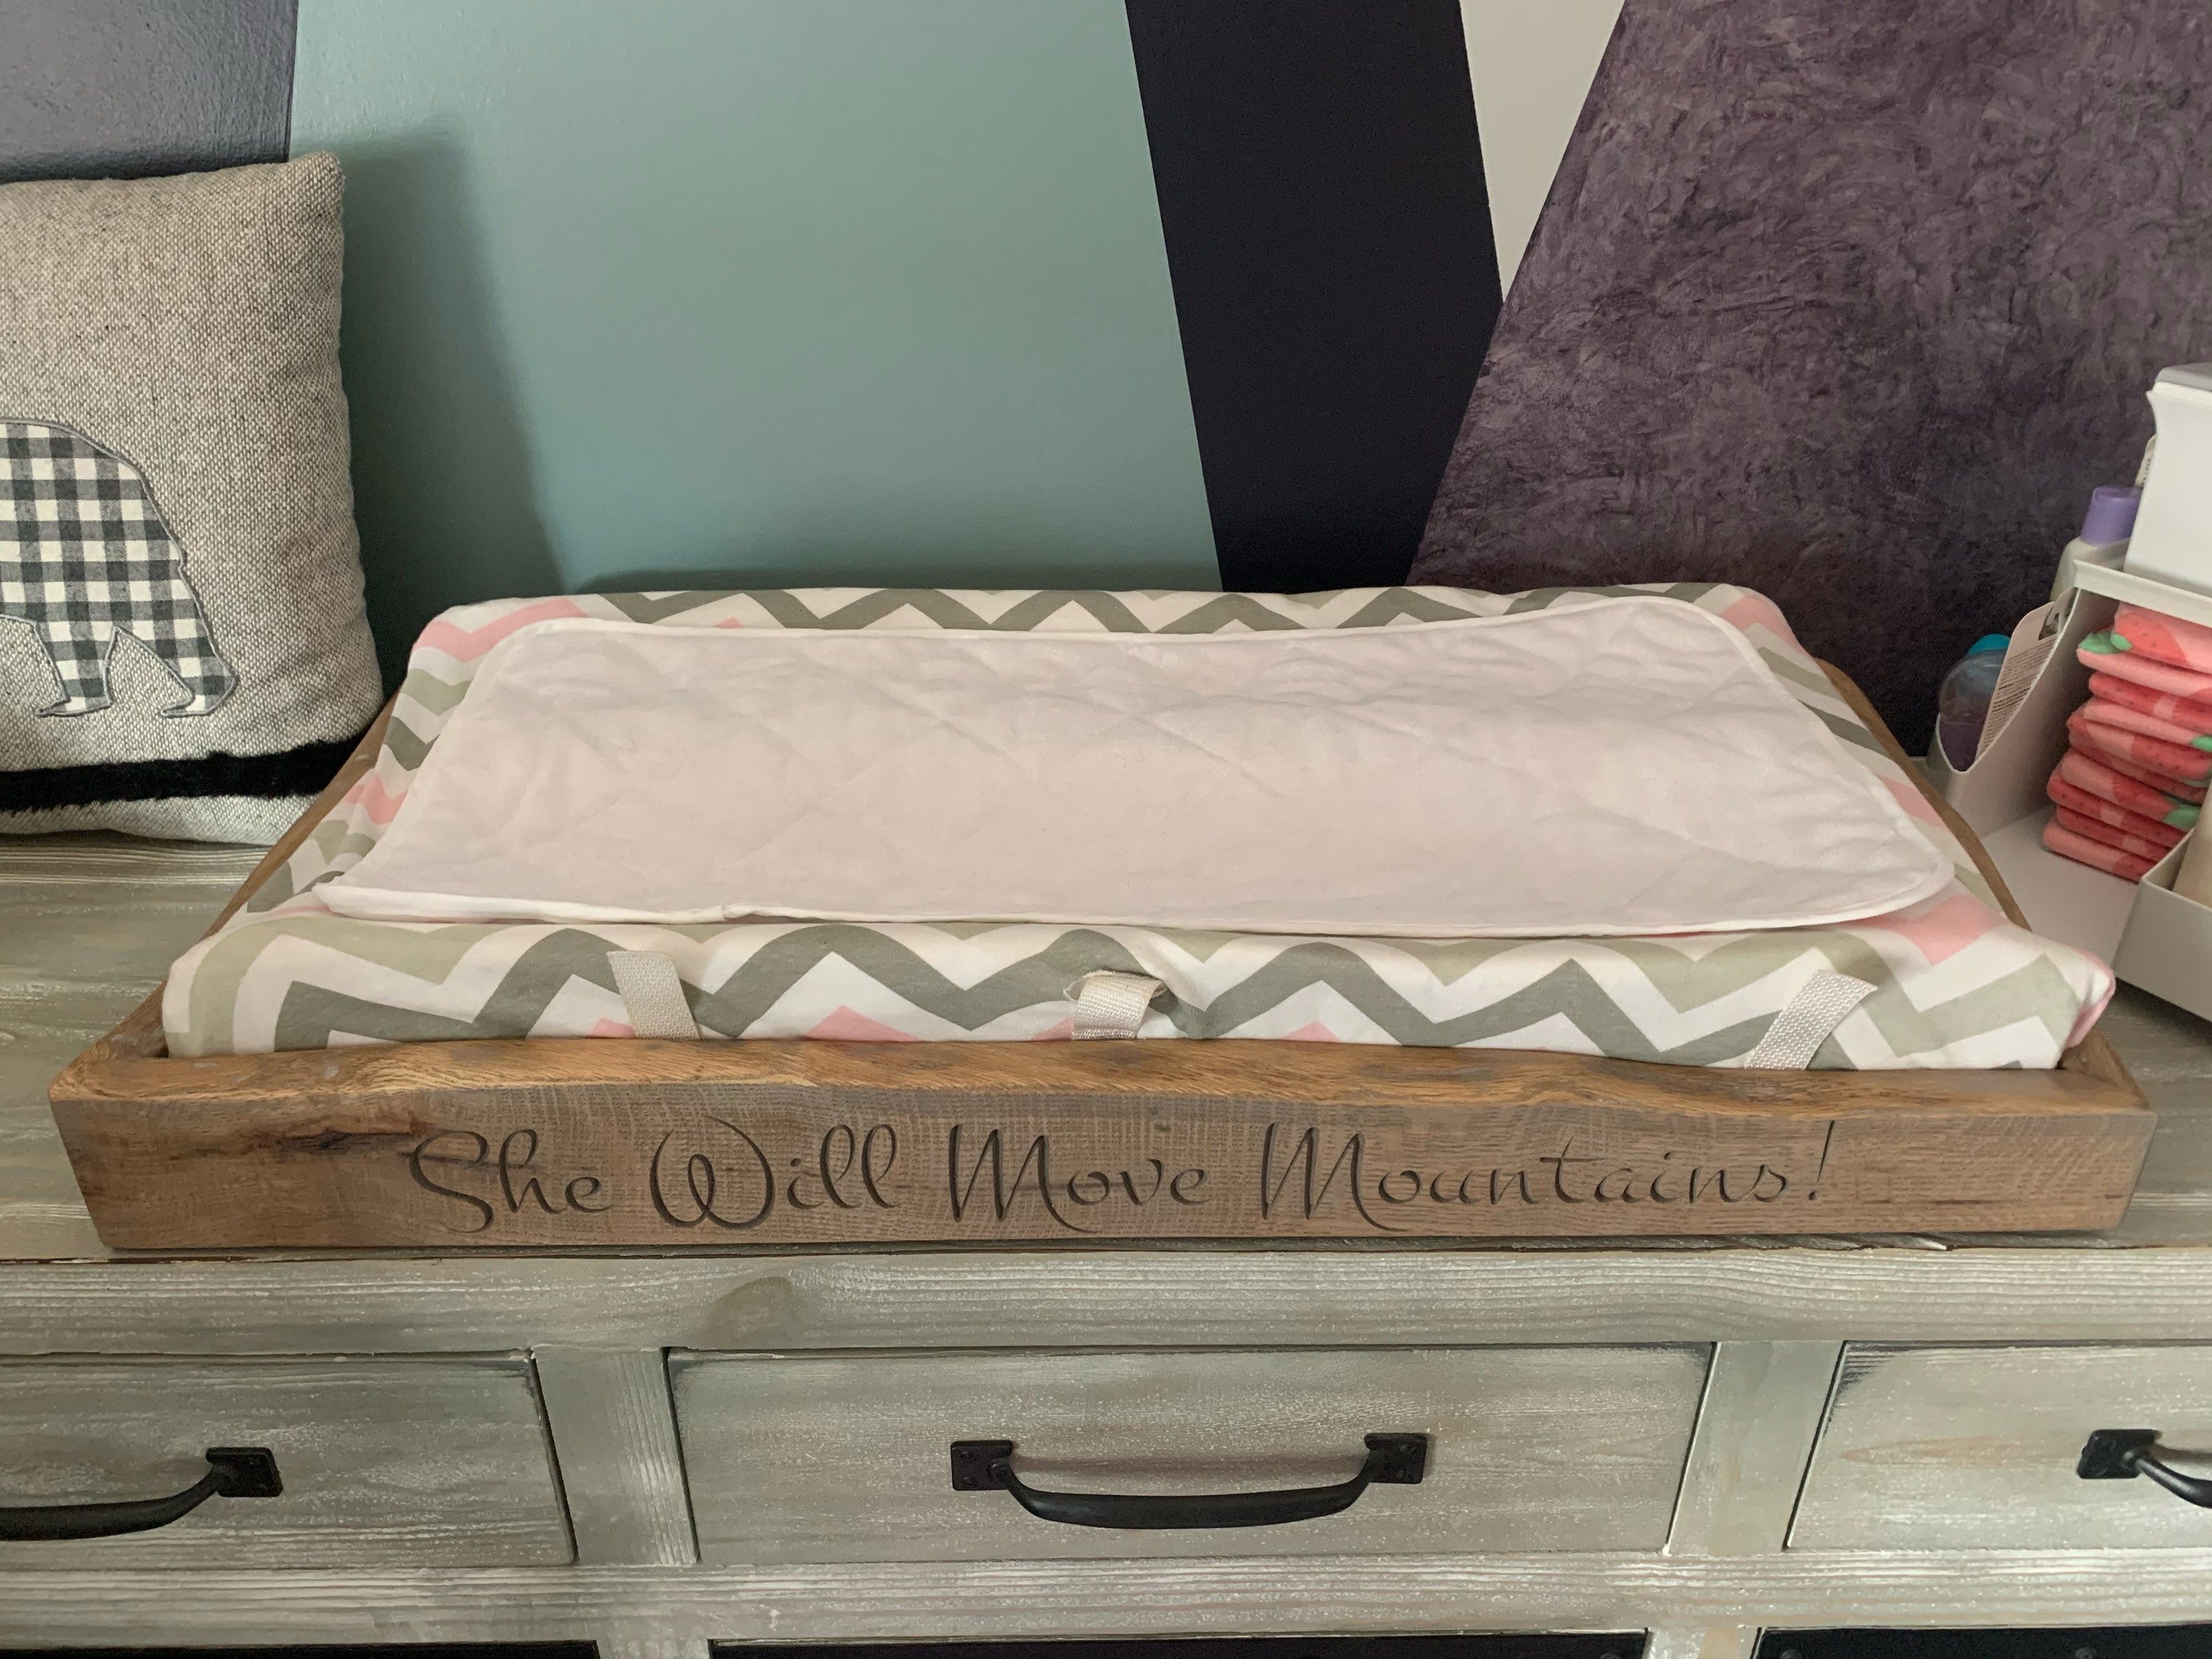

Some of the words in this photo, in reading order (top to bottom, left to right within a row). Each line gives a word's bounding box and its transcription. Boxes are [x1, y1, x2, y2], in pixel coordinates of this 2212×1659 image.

[409, 1128, 614, 1234] She
[649, 1115, 904, 1231] Will
[948, 1124, 1213, 1234] Move
[1262, 1120, 1835, 1232] Mountains!
